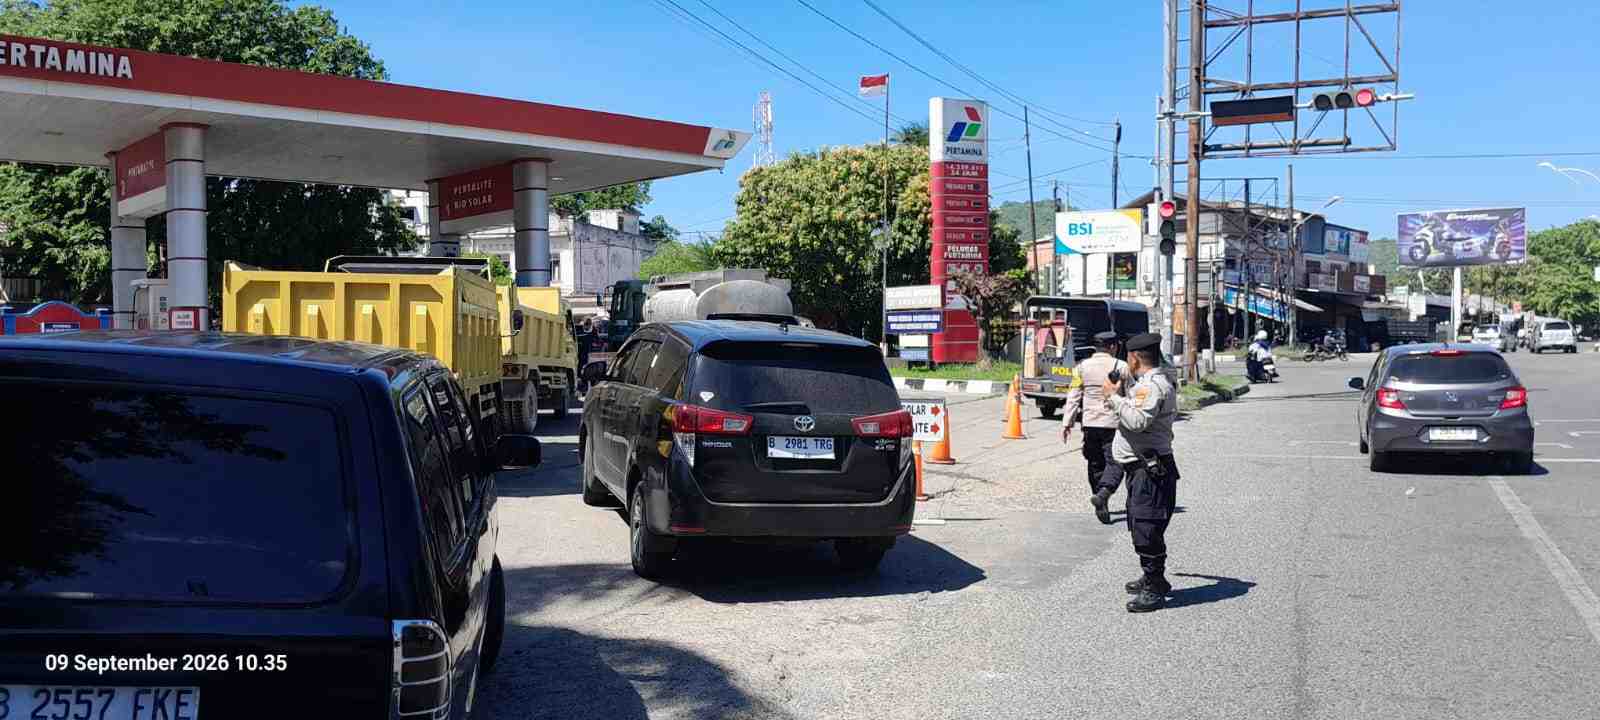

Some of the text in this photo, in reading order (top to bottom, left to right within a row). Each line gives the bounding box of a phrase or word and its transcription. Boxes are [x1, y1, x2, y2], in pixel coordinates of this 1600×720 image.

[946, 146, 983, 156] PERTAMINA
[1068, 223, 1093, 236] BSI
[1052, 366, 1073, 376] POL
[912, 422, 929, 433] ITE
[768, 437, 833, 450] B 2981 TRG
[30, 688, 117, 720] 2557
[132, 688, 193, 720] FKE
